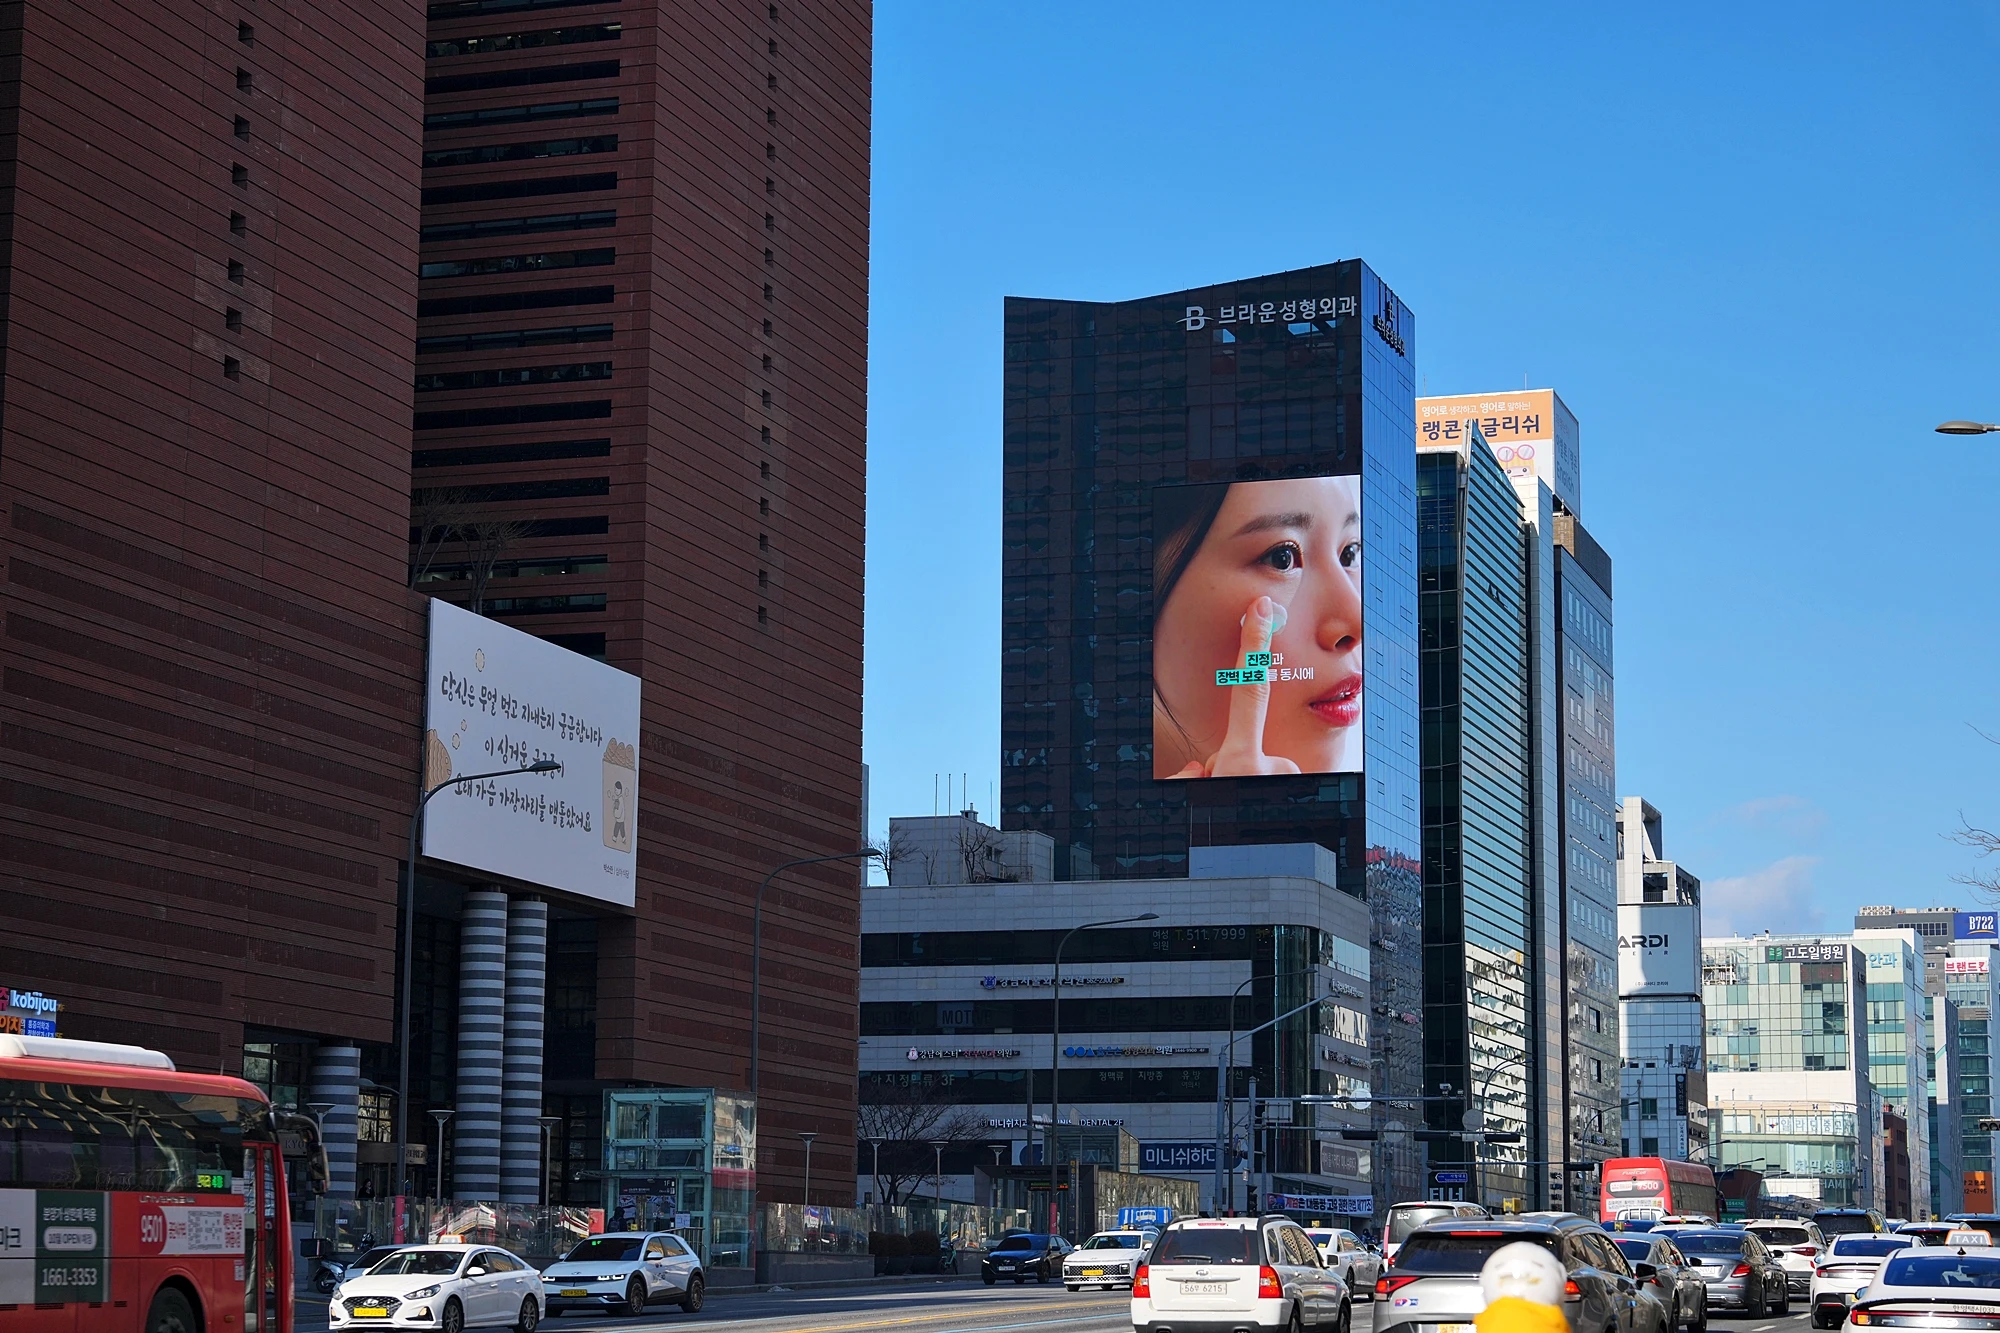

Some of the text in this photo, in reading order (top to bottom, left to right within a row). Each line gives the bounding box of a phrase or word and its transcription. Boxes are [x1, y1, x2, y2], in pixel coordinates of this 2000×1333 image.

[1218, 296, 1357, 324] 브라운성형외과
[1422, 405, 1448, 417] 영어로
[1480, 402, 1506, 414] 영어로
[1422, 414, 1540, 441] 랭콘글리쉬
[1247, 653, 1284, 667] 진정과
[1218, 667, 1314, 684] 장벽 보호를 동시에
[441, 671, 475, 706] 당신은
[479, 686, 497, 716] 무얼
[501, 694, 518, 719] 먹고
[521, 703, 555, 731] 지내는지
[485, 737, 494, 756] 이
[497, 734, 528, 769] 싱거운
[476, 779, 496, 806] 가슴
[500, 787, 546, 822] 가장자리를
[549, 800, 592, 832] 맴돌았어요
[1969, 915, 1994, 930] B722
[1152, 929, 1169, 940] 여성
[1618, 935, 1668, 948] ARDI
[1152, 941, 1169, 951] 의원
[1784, 945, 1844, 960] 고도일병원
[10, 990, 57, 1015] kobijou
[941, 1074, 955, 1086] 3F
[1099, 1071, 1125, 1082] 정맥류
[1080, 1119, 1112, 1127] DENTAL
[141, 1214, 163, 1242] 9501
[63, 1233, 81, 1244] OPEN
[1954, 1235, 1984, 1244] TAXI
[41, 1268, 98, 1286] 1661-3353
[1203, 1284, 1222, 1292] 6215
